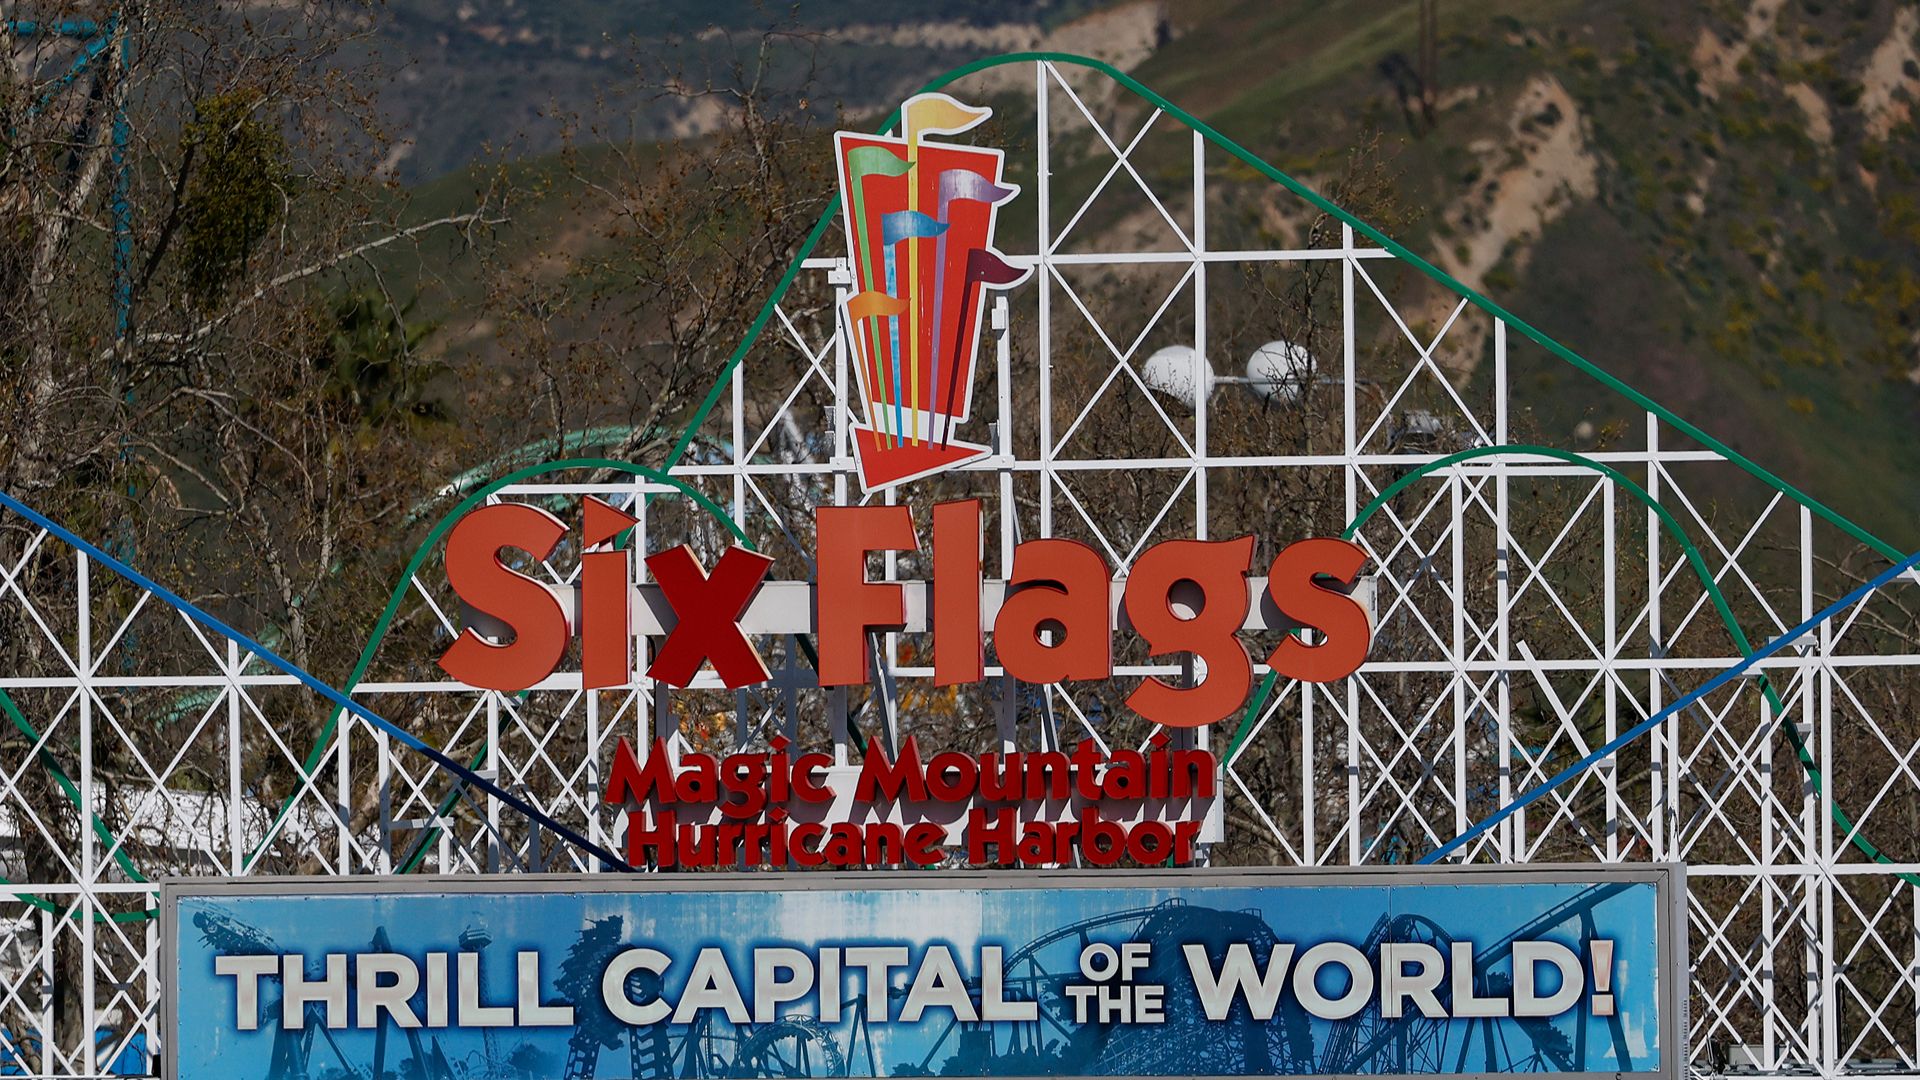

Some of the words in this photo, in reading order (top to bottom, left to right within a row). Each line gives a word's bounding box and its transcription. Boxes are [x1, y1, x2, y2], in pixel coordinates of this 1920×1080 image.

[437, 495, 776, 690] Six
[816, 499, 1372, 728] Flags
[605, 735, 836, 818] Magic
[855, 731, 1217, 802] Mountain
[628, 807, 949, 867] Hurricane
[968, 806, 1200, 865] Harbor
[215, 951, 574, 1030] THRILL
[602, 945, 1038, 1025] CAPITAL
[1079, 942, 1152, 982] OF
[1182, 939, 1615, 1021] WORLD!
[1065, 985, 1165, 1024] THE
